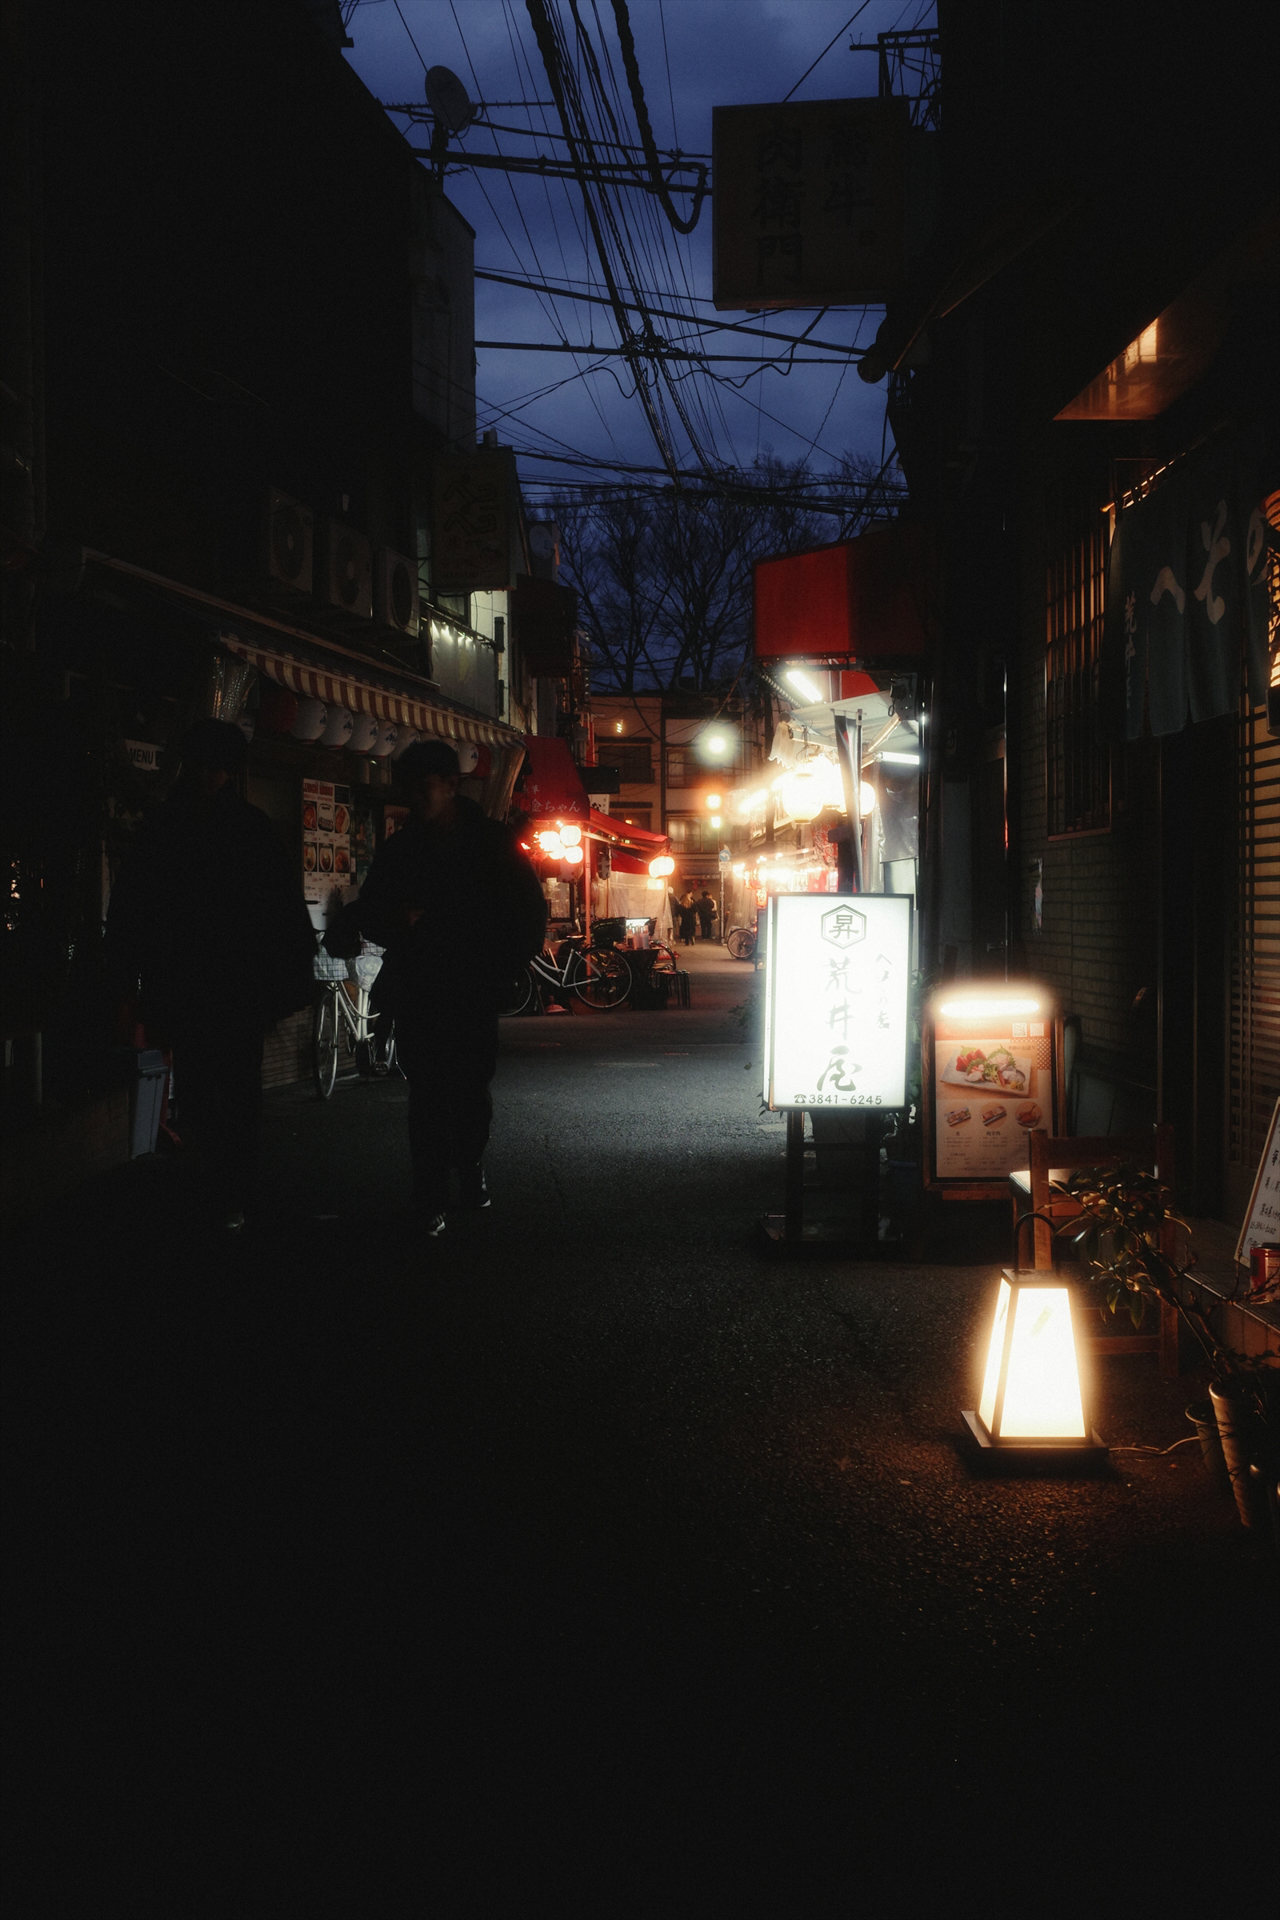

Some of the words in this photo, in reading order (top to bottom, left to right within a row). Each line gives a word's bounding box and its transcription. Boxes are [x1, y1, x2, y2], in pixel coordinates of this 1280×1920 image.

[130, 748, 154, 765] MENU
[532, 798, 582, 813] 金ちゃん
[829, 914, 860, 940] 昇
[816, 955, 864, 1092] 荒井屋
[809, 1094, 882, 1105] 3841-6245
